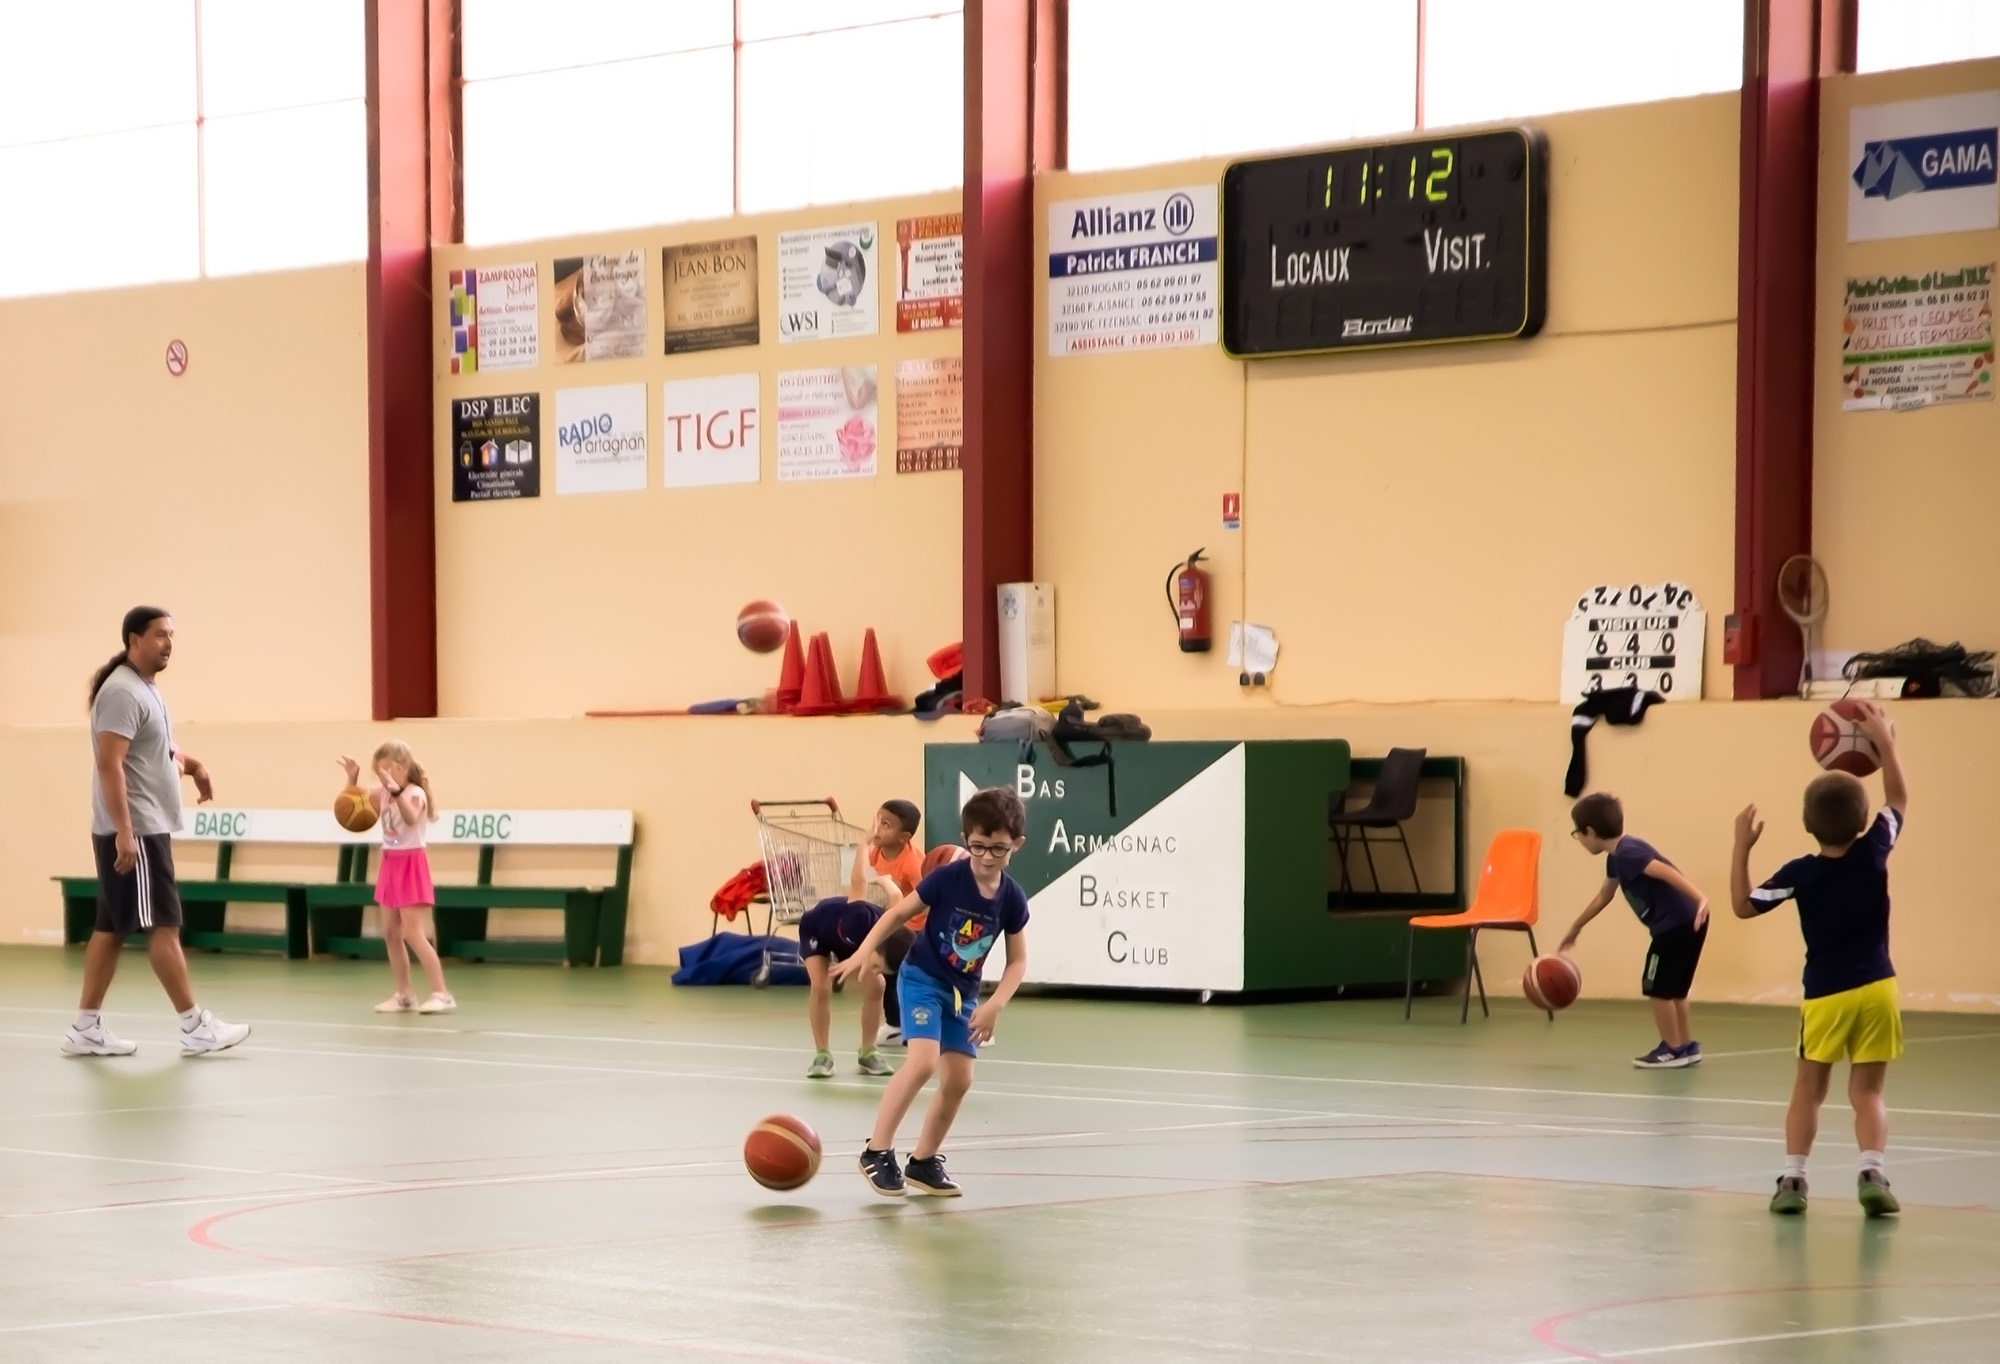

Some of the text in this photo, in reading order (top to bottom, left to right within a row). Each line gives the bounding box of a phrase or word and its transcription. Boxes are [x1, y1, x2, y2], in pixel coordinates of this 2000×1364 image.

[1921, 143, 1994, 177] GAMA
[1325, 147, 1454, 209] 11:12
[1071, 206, 1157, 239] Allianz
[724, 241, 735, 251] DE
[921, 238, 956, 251] Carrosserie
[625, 250, 639, 265] du
[1067, 242, 1200, 275] Patrick FRANCH
[479, 266, 536, 284] ZAMPROGNA
[590, 266, 638, 285] Boulanger
[922, 274, 958, 286] Location de
[1091, 279, 1131, 295] NOGARO
[1136, 279, 1148, 290] 05
[1150, 278, 1161, 289] 62
[1177, 275, 1188, 286] 01
[1087, 297, 1135, 313] PLAISANCE
[1154, 295, 1167, 307] 62
[1881, 299, 1908, 310] HOUGA
[788, 310, 819, 333] WSI
[911, 316, 945, 330] LE HOUGA
[1161, 311, 1173, 323] 62
[1862, 314, 1906, 331] FRUITS
[1908, 317, 1918, 327] et
[1070, 335, 1126, 351] ASSISTANCE
[1140, 332, 1157, 344] 800
[1853, 331, 1917, 350] VOLAILLES
[1869, 365, 1905, 376] NOGARO
[896, 376, 939, 388] Menuisier
[1871, 376, 1901, 386] HOUGA
[1886, 385, 1919, 395] AIGNAN
[461, 395, 531, 419] DSP ELEC
[559, 412, 613, 448] RADIO
[667, 408, 757, 452] TIGF
[900, 450, 912, 461] 06
[470, 489, 491, 499] Portail
[1629, 584, 1642, 606] 0
[1597, 616, 1671, 632] VISITEUR
[1595, 632, 1675, 655] 6 4 0
[1609, 656, 1652, 670] CLUB
[1659, 671, 1673, 694] 0
[194, 811, 247, 838] BABC
[452, 813, 512, 841] BABC
